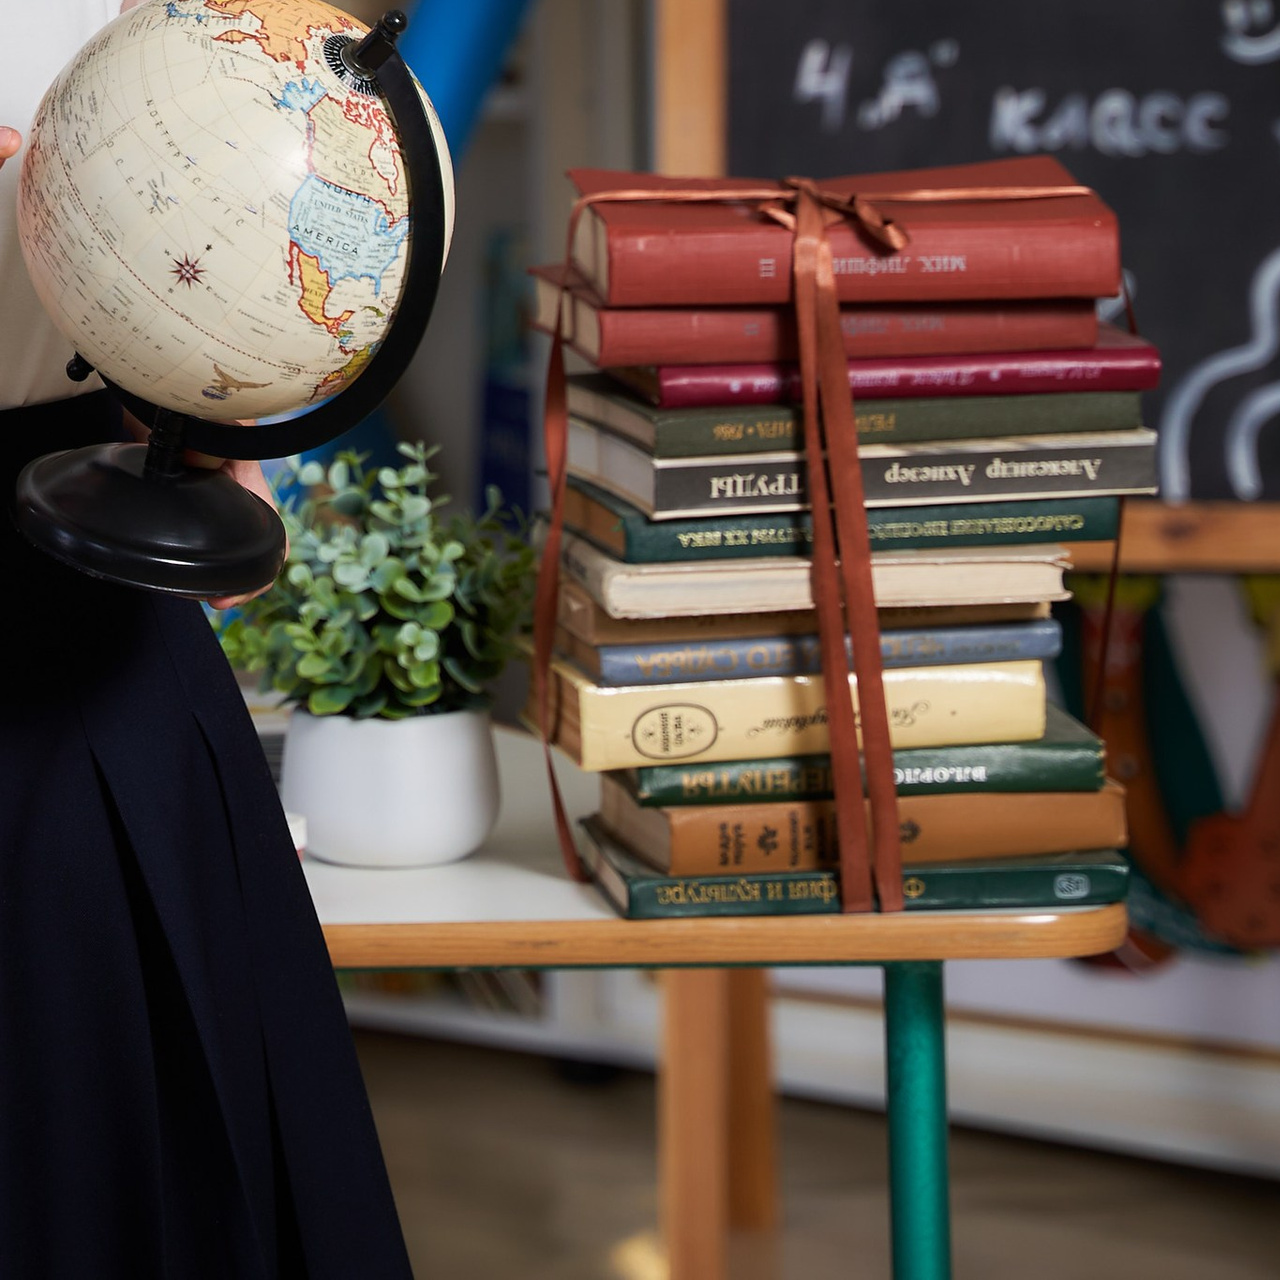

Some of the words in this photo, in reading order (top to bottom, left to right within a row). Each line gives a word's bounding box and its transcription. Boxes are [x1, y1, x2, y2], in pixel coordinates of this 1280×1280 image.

[988, 85, 1227, 157] КЛАСС
[323, 154, 375, 179] CANADA
[322, 180, 372, 205] NORTH
[313, 199, 342, 214] UNITED
[345, 209, 369, 224] STATES
[292, 223, 359, 255] AMERICA
[832, 256, 911, 277] ЛИФШИ
[883, 462, 976, 487] Ахиезер
[984, 457, 1103, 481] Александр
[709, 473, 804, 499] ТРУДЫ
[633, 644, 739, 678] СУДЬБА
[681, 767, 833, 798] ЕРЕПУТЬЯ
[893, 766, 988, 785] ВЛ.ОРЛО
